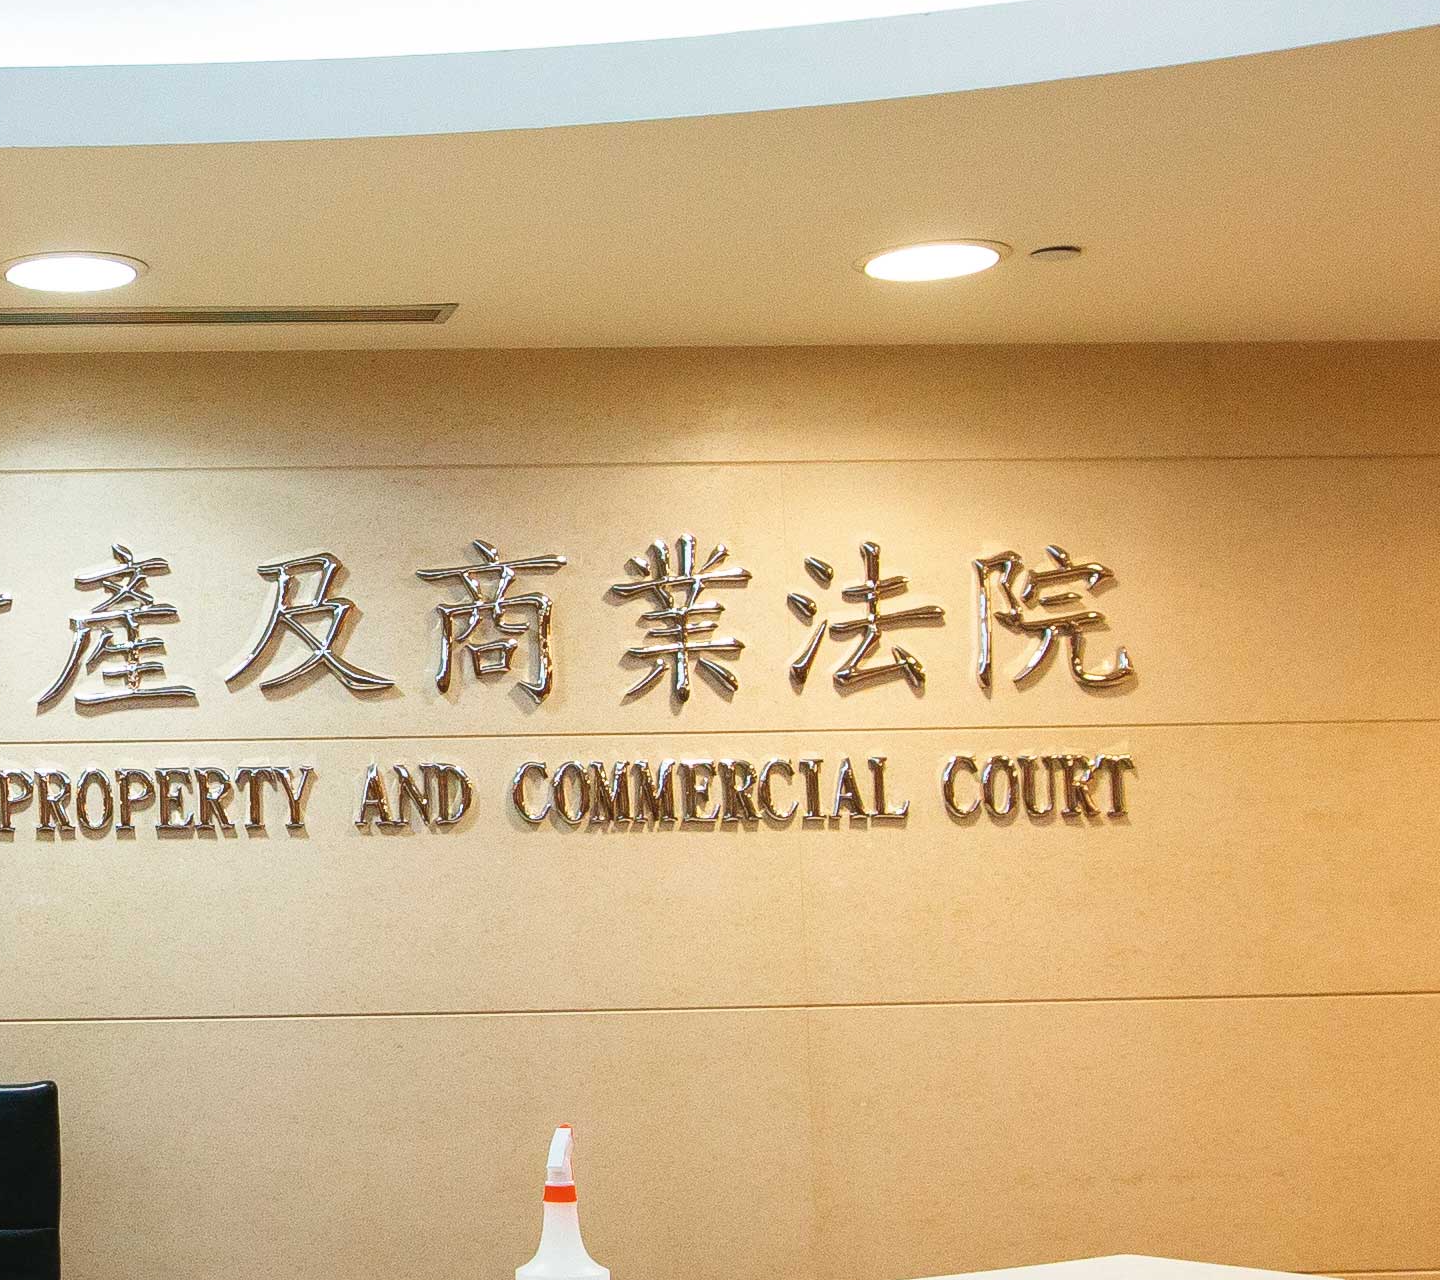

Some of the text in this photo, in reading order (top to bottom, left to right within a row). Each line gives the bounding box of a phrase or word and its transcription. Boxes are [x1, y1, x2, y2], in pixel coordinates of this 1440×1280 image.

[354, 763, 474, 828] AND
[512, 756, 910, 825] COMMERCIAL
[942, 753, 1135, 819] COURT
